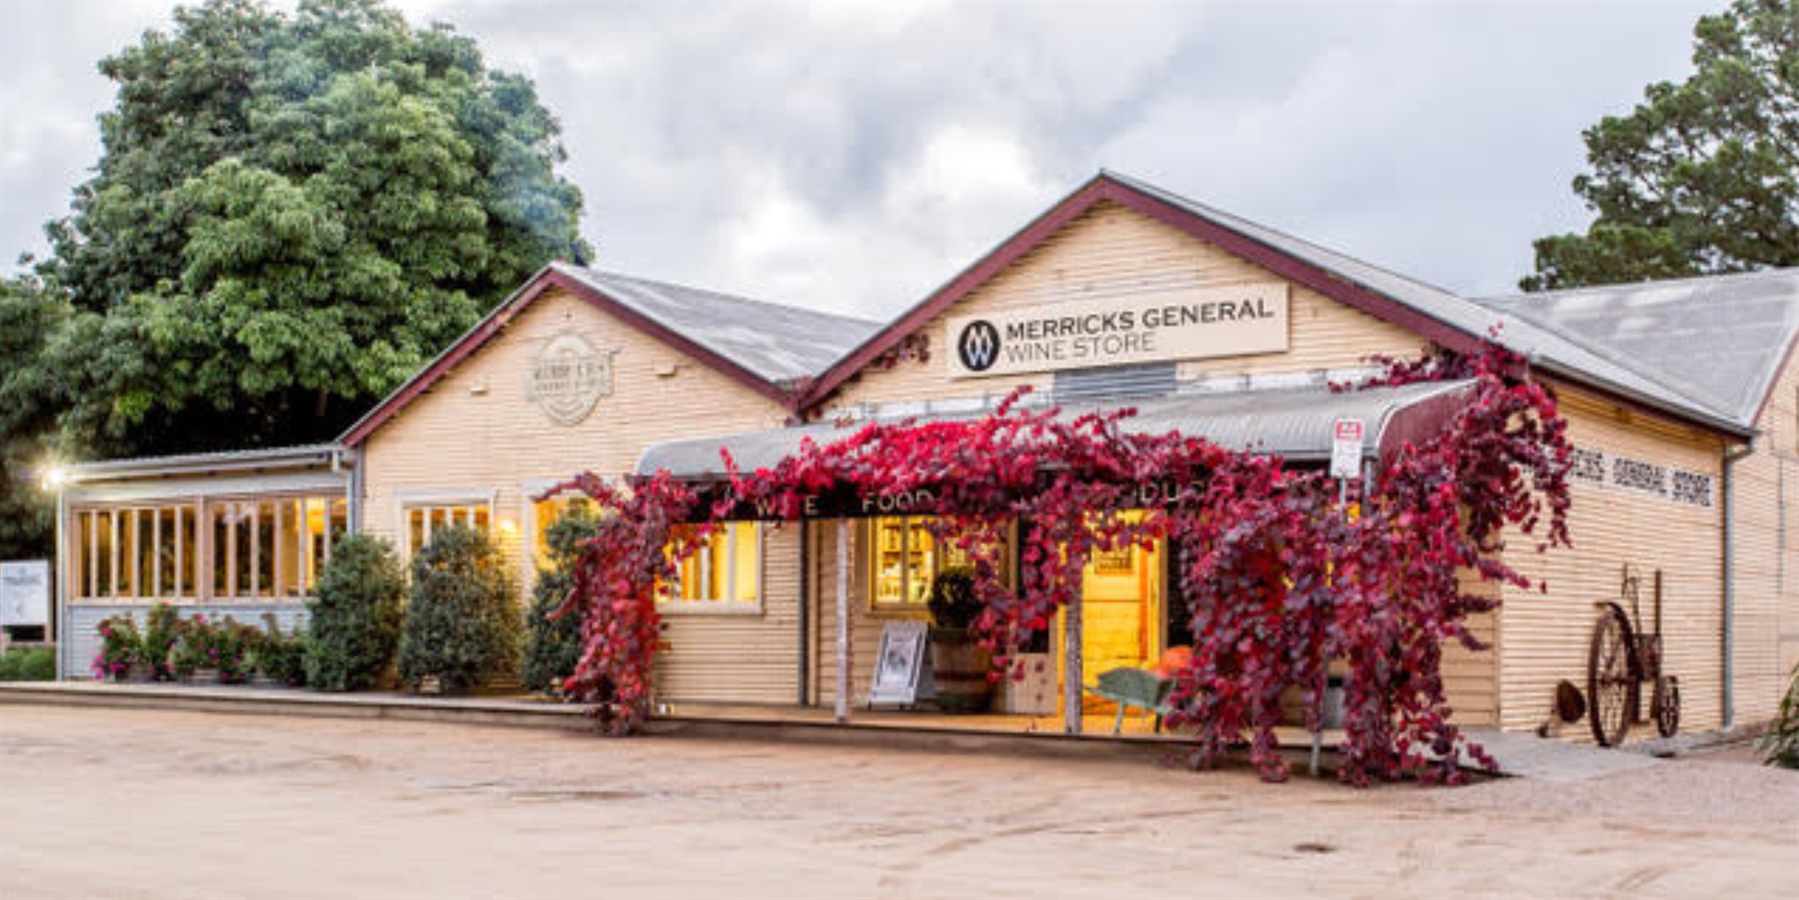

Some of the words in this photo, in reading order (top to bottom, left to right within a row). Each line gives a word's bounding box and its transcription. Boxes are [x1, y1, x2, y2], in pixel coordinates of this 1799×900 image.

[1006, 312, 1134, 340] MERRICKS
[1142, 298, 1274, 329] GENERAL
[1006, 340, 1066, 363] WINE
[1073, 331, 1155, 358] STORE
